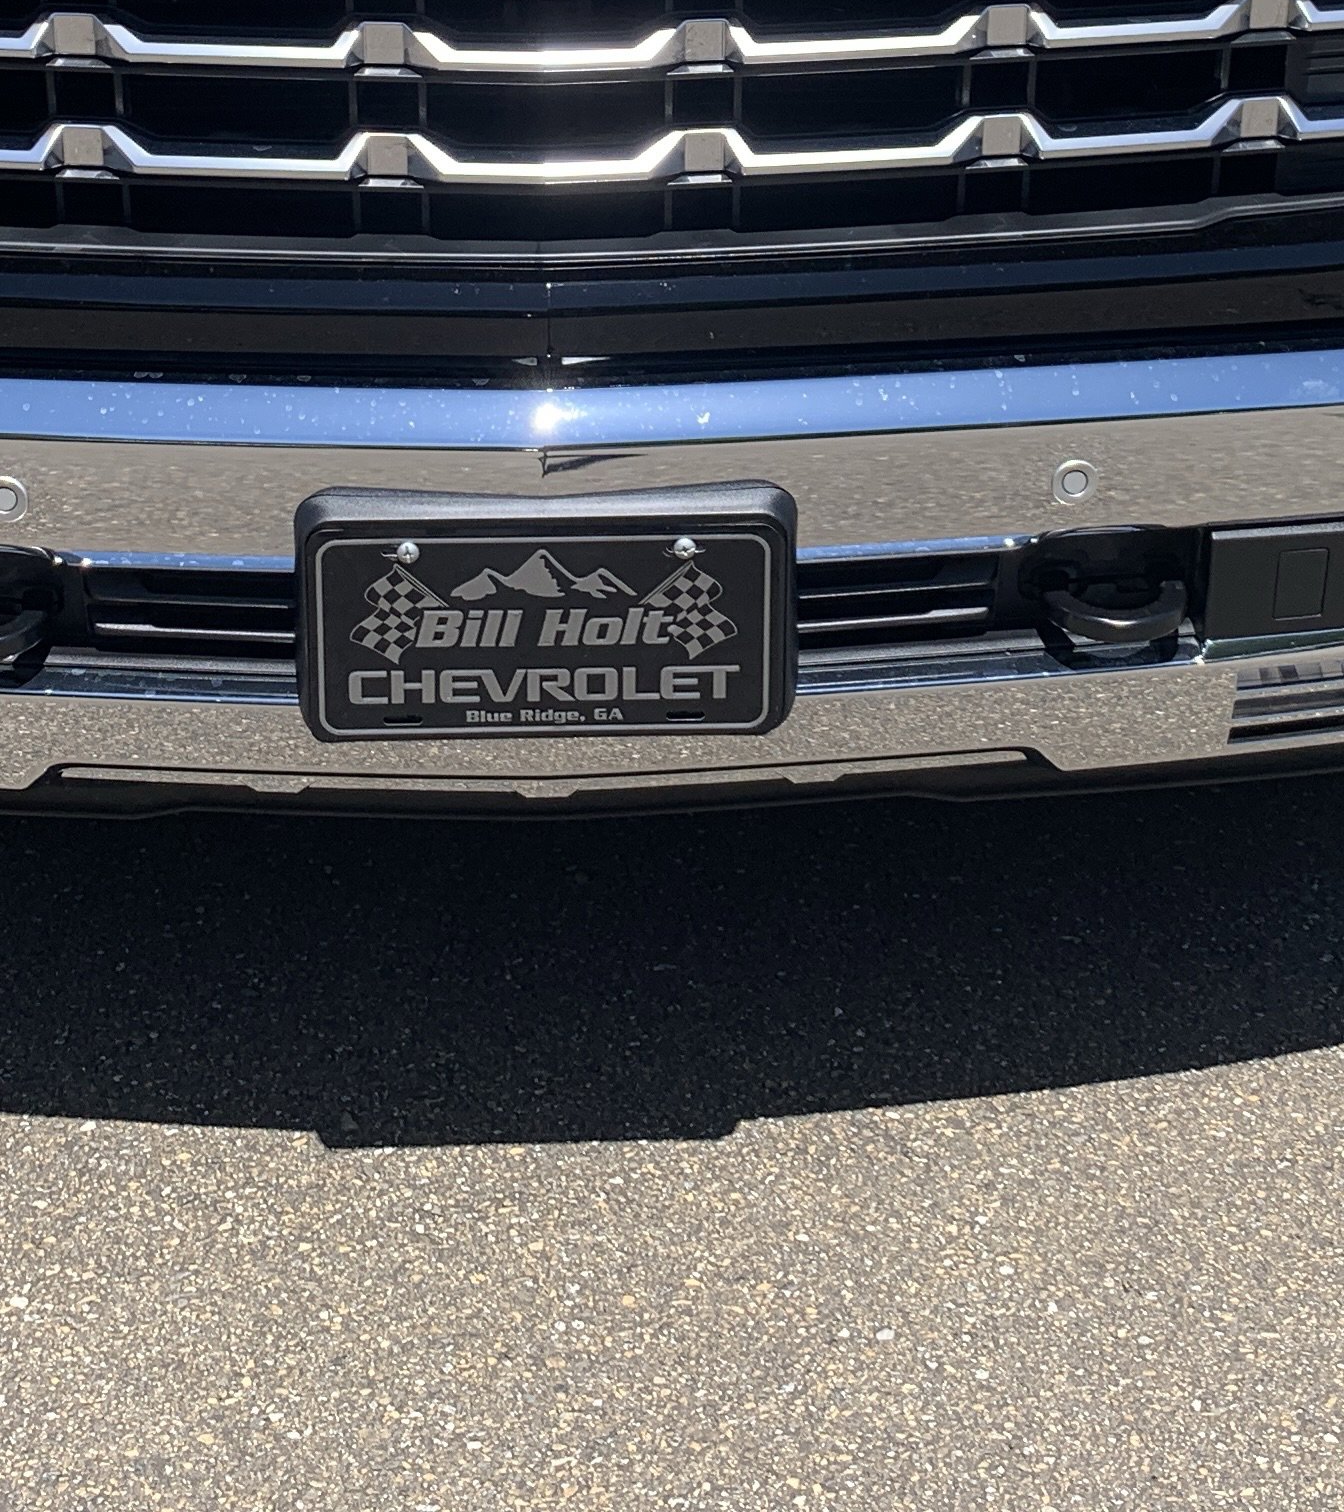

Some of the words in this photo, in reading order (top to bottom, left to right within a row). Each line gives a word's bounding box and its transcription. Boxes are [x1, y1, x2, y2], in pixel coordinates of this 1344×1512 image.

[414, 608, 524, 648] Bill
[537, 607, 675, 647] Holt
[348, 664, 741, 705] CHEVROLET
[465, 709, 513, 723] Blue
[519, 708, 586, 724] Ridge,
[593, 707, 624, 722] GA
